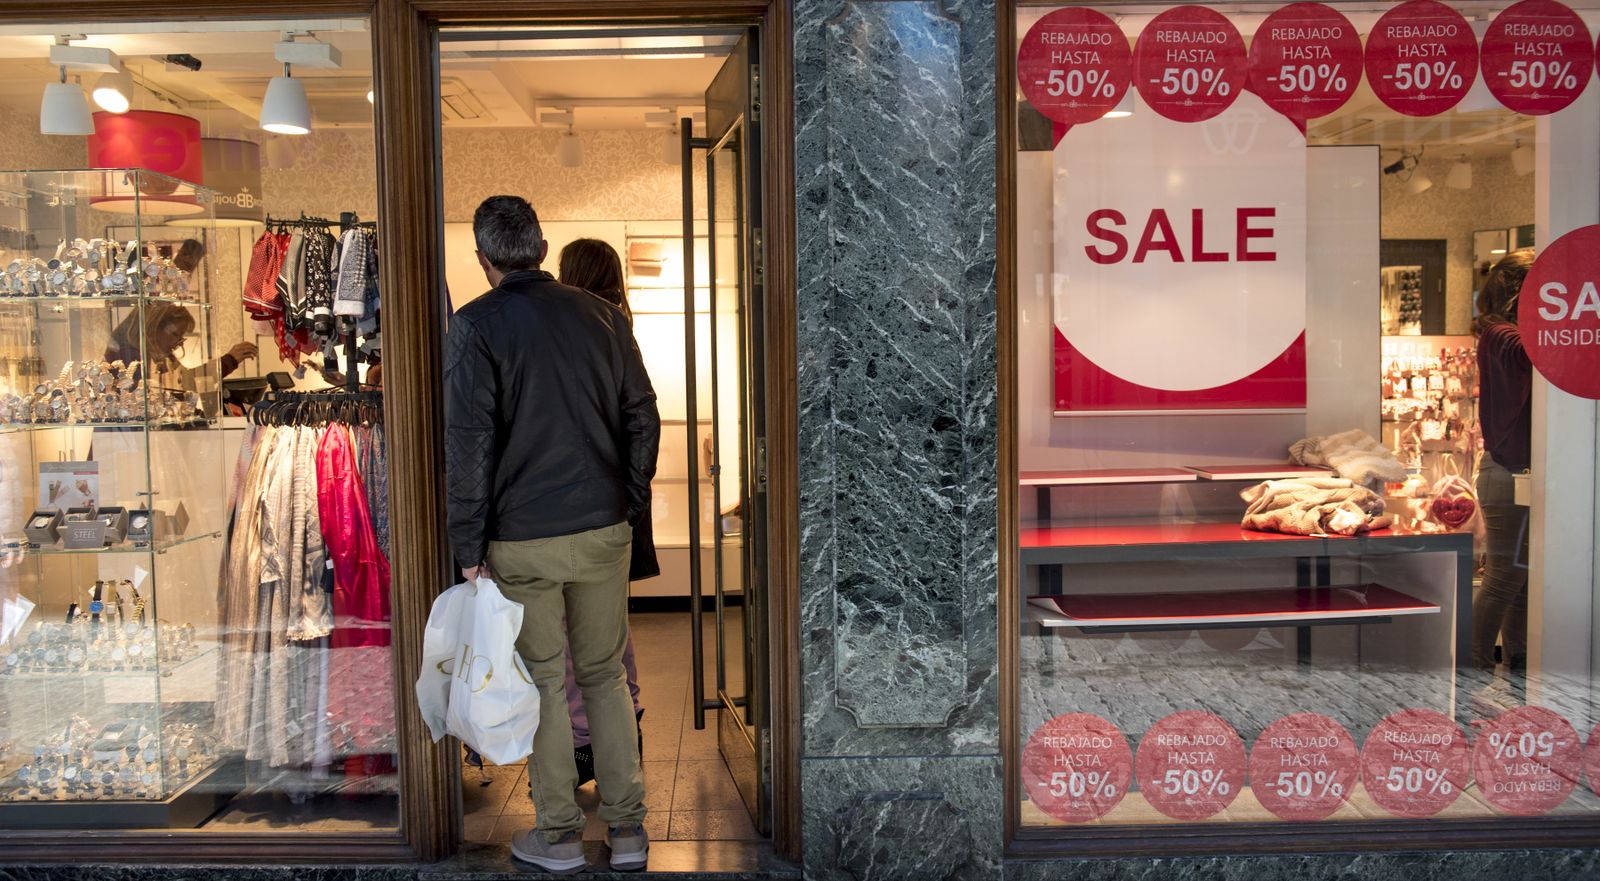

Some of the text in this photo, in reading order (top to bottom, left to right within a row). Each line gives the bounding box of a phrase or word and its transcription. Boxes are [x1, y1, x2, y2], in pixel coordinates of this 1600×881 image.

[1155, 30, 1227, 44] REBAJADO
[1271, 27, 1342, 40] REBAJADO
[1386, 25, 1458, 38] REBAJADO
[1504, 24, 1575, 37] REBAJADO
[1041, 32, 1112, 46] REBAJADO
[1166, 49, 1216, 63] HASTA
[1282, 46, 1332, 60] HASTA
[1397, 43, 1447, 58] HASTA
[1514, 42, 1564, 57] HASTA
[1051, 51, 1101, 65] HASTA
[1150, 68, 1230, 96] -50%
[1266, 63, 1347, 92] -50%
[1382, 61, 1463, 90] -50%
[1497, 60, 1578, 90] -50%
[1035, 70, 1116, 98] -50%
[1084, 207, 1277, 265] SALE
[1538, 281, 1600, 322] SA
[74, 529, 96, 539] STEEL
[1043, 735, 1113, 749] REBAJADO
[1157, 734, 1226, 747] REBAJADO
[1271, 736, 1339, 749] REBAJADO
[1384, 731, 1452, 746] REBAJADO
[1489, 731, 1567, 760] -50%
[1054, 754, 1102, 767] HASTA
[1167, 752, 1215, 765] HASTA
[1280, 753, 1328, 767] HASTA
[1392, 749, 1440, 763] HASTA
[1503, 762, 1552, 776] HASTA
[1038, 771, 1117, 799] -50%
[1152, 769, 1230, 796] -50%
[1265, 770, 1343, 800] -50%
[1375, 766, 1452, 796] -50%
[1493, 780, 1561, 794] REBAJADO
